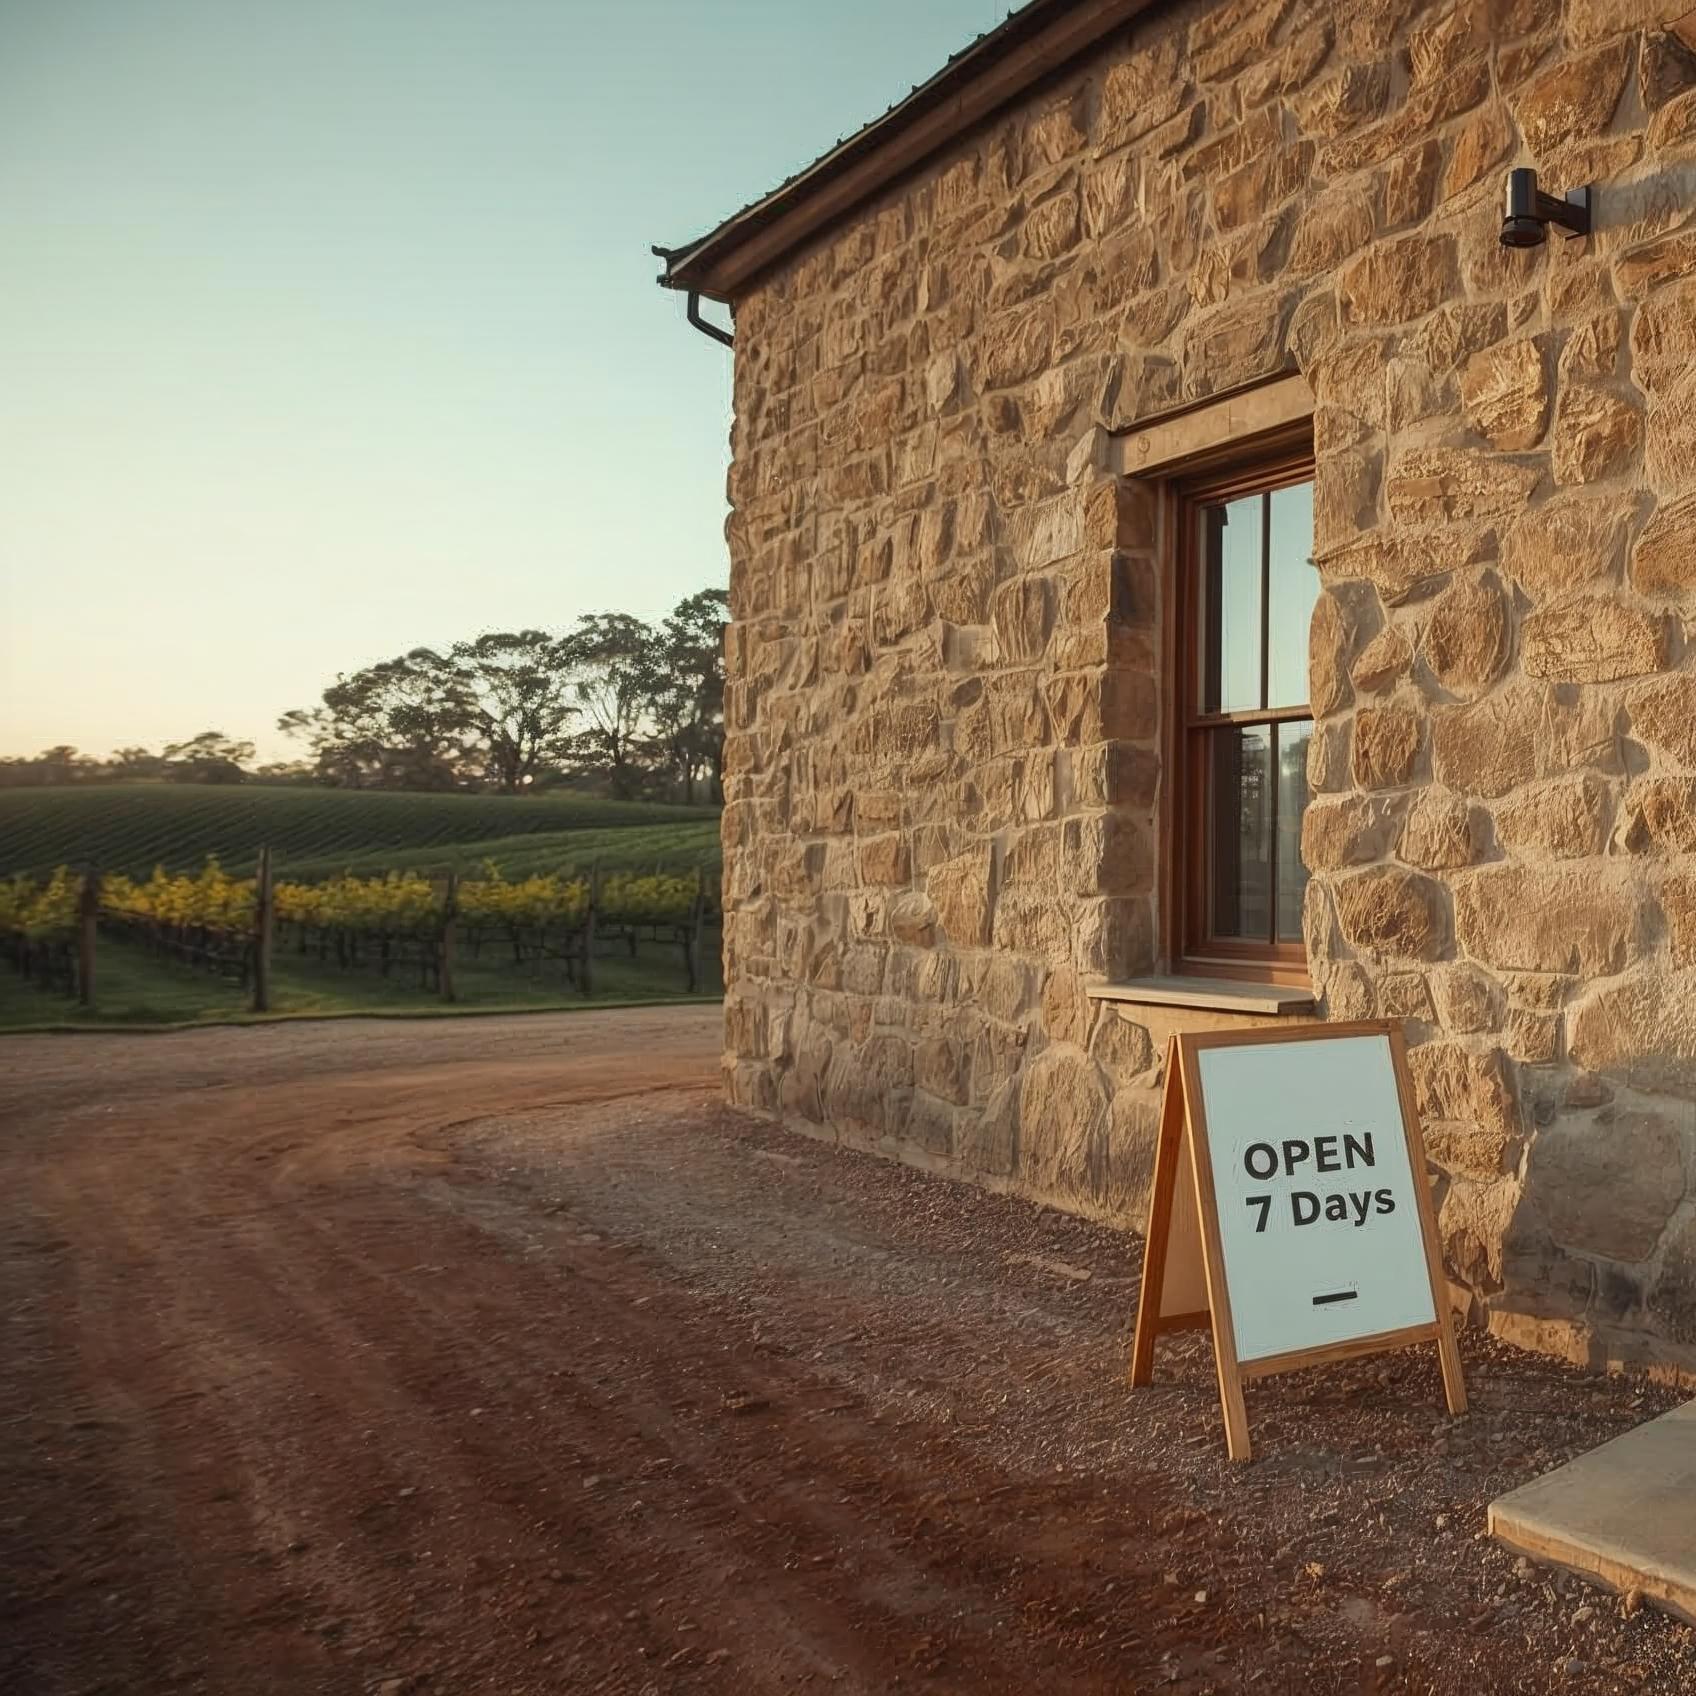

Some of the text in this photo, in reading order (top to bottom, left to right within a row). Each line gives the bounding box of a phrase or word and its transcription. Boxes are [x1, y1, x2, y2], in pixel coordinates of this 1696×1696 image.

[1243, 1131, 1376, 1181] OPEN
[1245, 1188, 1396, 1233] 7 Days
